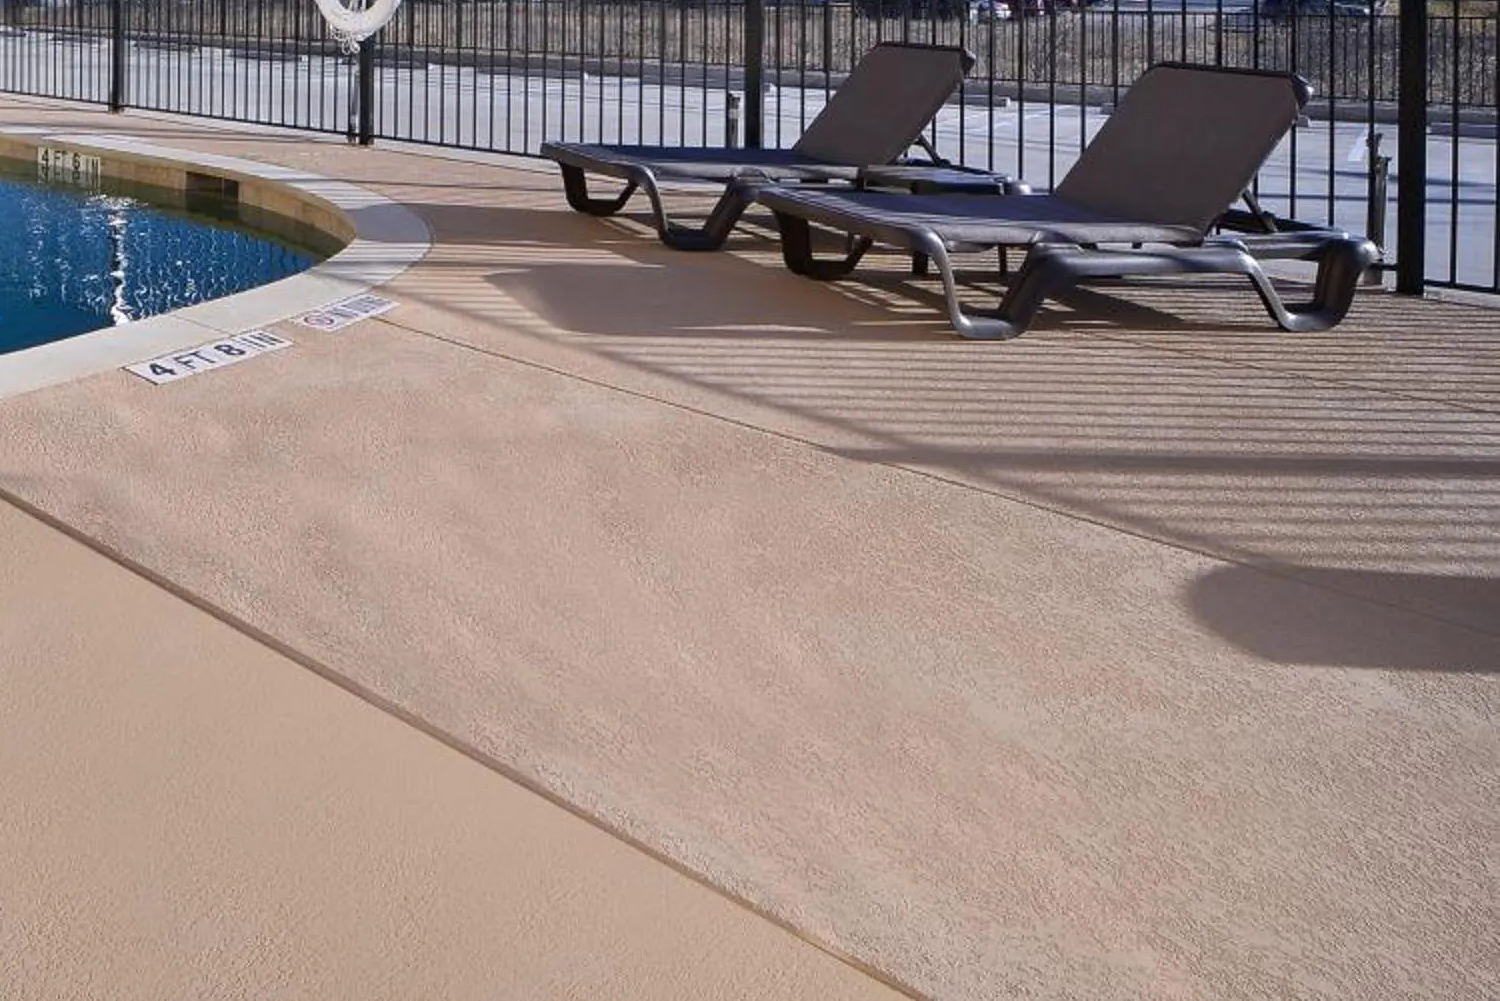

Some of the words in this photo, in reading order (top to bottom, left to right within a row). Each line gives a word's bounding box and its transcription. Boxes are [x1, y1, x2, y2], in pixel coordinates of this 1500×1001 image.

[41, 147, 49, 165] 4
[54, 150, 68, 167] FT
[85, 157, 99, 173] IN
[148, 362, 177, 376] 4
[173, 350, 216, 369] FT
[213, 343, 246, 356] 8
[240, 332, 284, 349] IN
